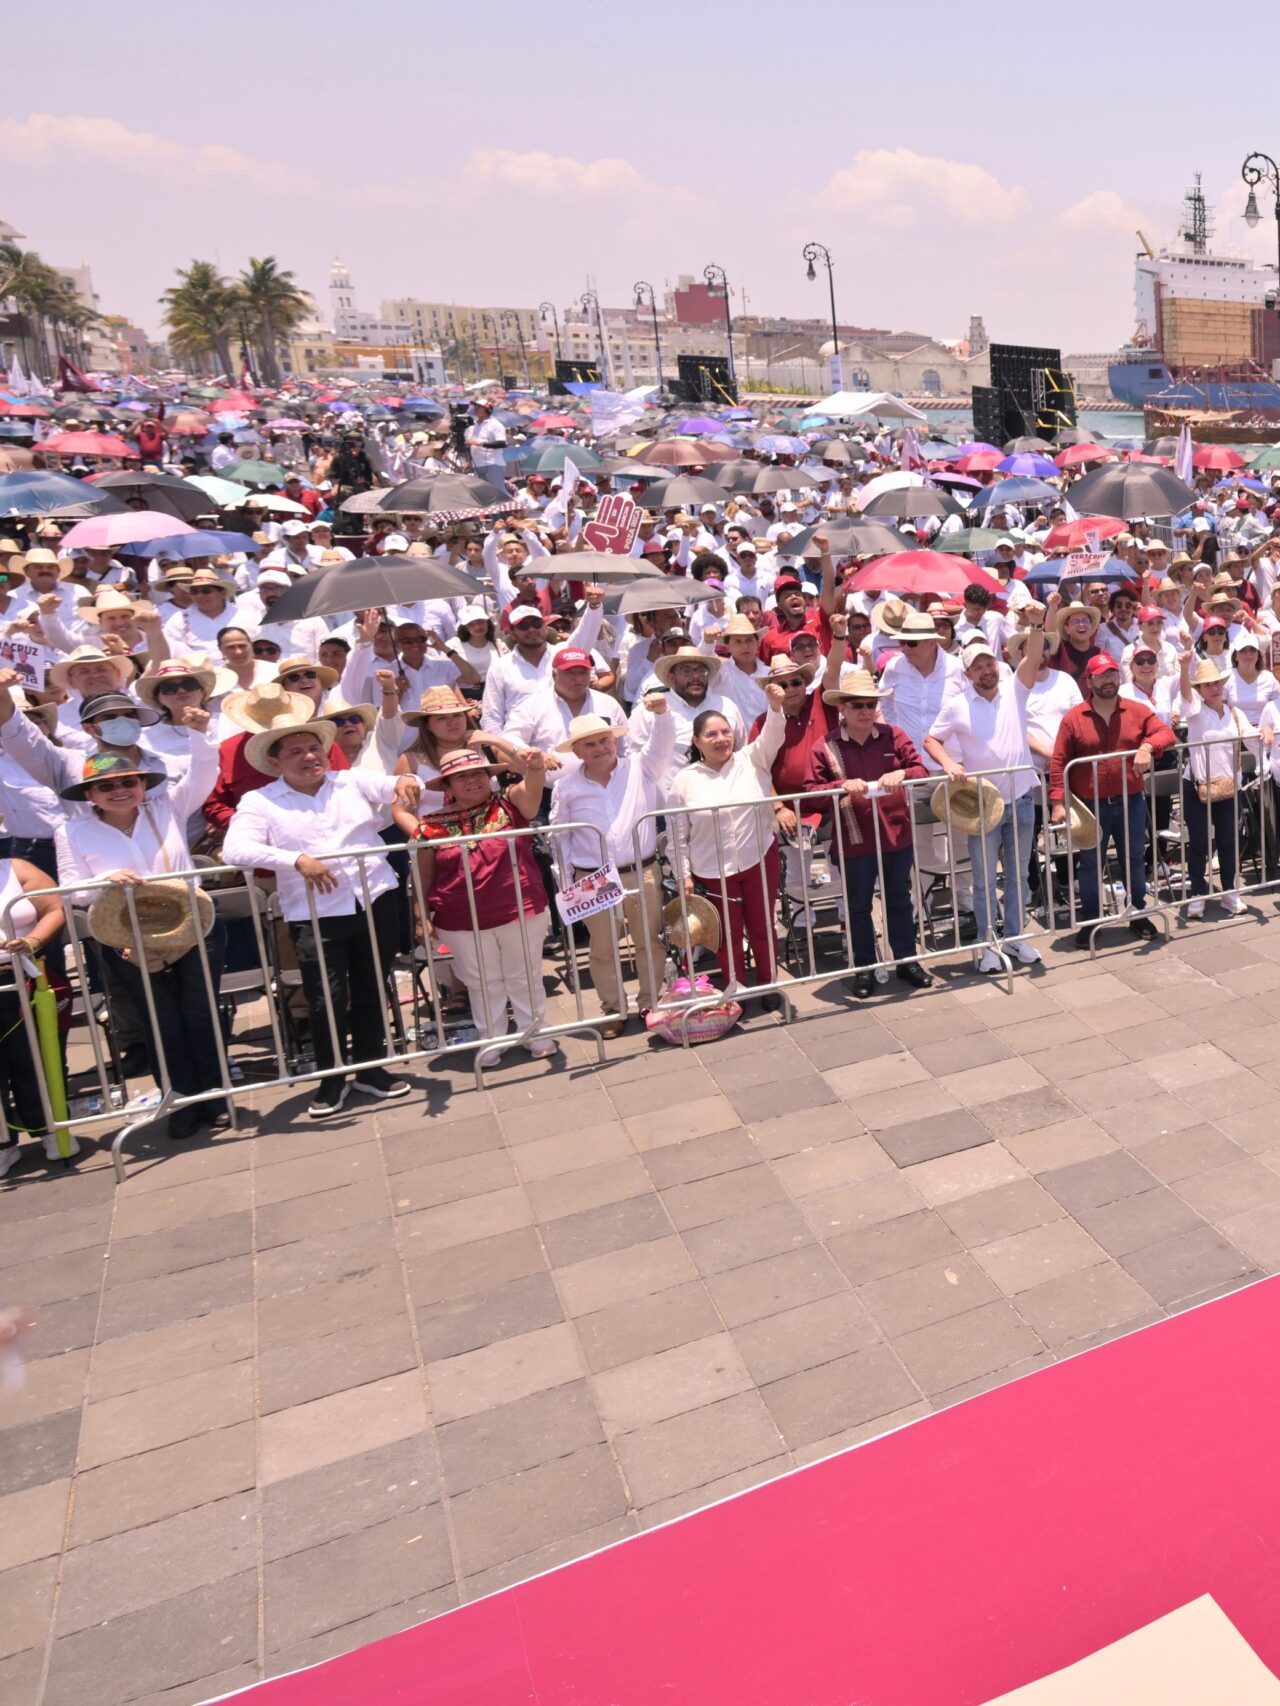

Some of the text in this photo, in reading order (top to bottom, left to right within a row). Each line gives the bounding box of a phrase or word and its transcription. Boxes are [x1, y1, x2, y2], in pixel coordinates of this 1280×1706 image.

[624, 510, 641, 549] POZA RICA
[562, 864, 612, 895] VERACRUZ
[566, 888, 623, 916] morena
